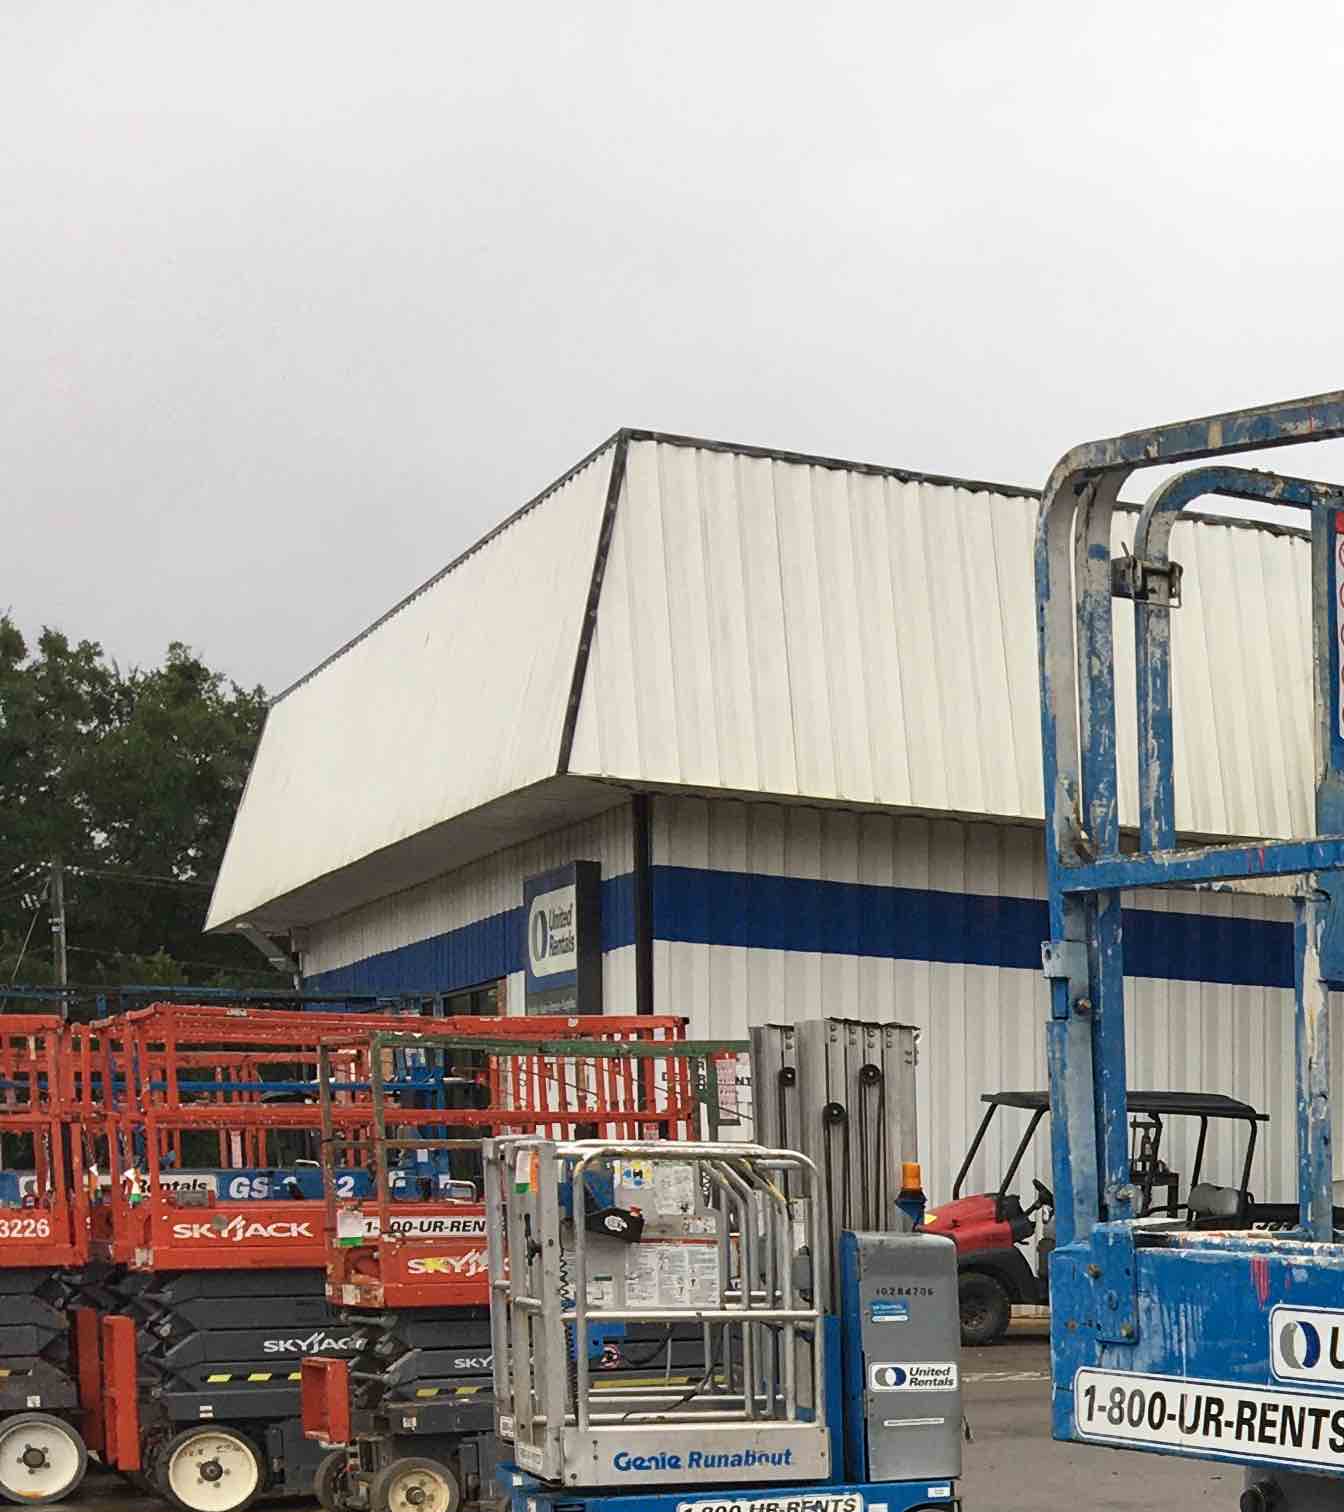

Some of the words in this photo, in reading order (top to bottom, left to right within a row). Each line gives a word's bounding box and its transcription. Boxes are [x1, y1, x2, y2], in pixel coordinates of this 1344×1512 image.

[909, 1366, 951, 1377] United
[909, 1377, 955, 1387] Rentals
[613, 1451, 682, 1472] Genie
[688, 1449, 793, 1469] Runabout
